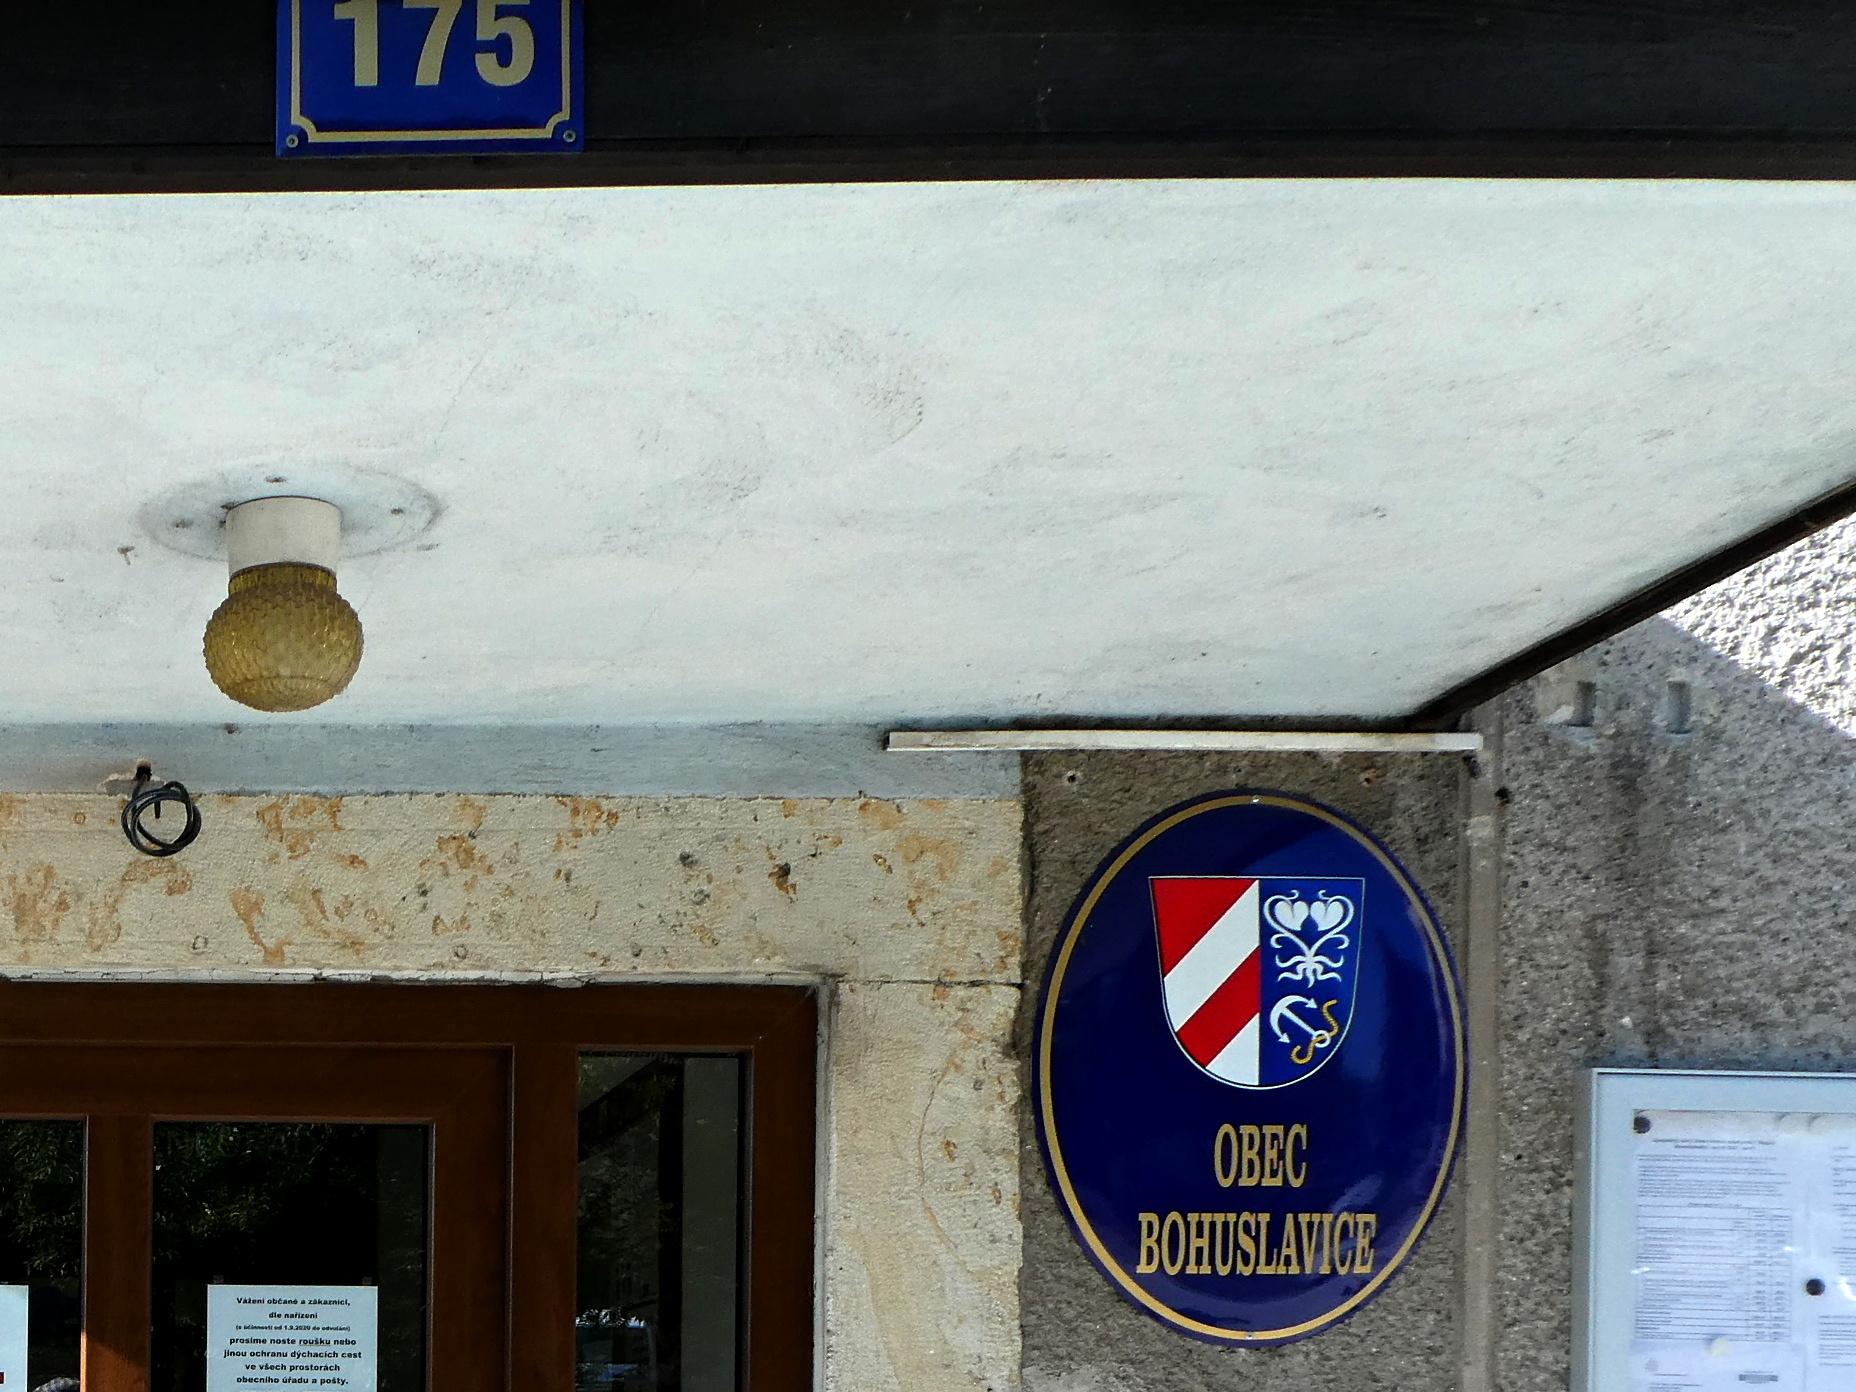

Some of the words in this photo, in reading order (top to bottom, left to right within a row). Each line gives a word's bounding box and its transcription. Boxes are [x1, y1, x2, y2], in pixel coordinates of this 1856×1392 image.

[334, 0, 535, 87] 175
[1214, 1123, 1307, 1187] OBEC
[1136, 1212, 1377, 1275] BOHUSLAVICE
[229, 1337, 267, 1345] prosíme
[299, 1337, 331, 1345] roušku
[223, 1350, 247, 1358] jinou
[249, 1350, 288, 1358] ochranu
[290, 1350, 339, 1359] dýchacích
[341, 1351, 362, 1359] cest
[259, 1363, 287, 1371] všech
[289, 1363, 340, 1372] prostorách
[236, 1376, 279, 1384] obecního
[282, 1376, 309, 1384] úřadu
[320, 1377, 349, 1386] pošty.
